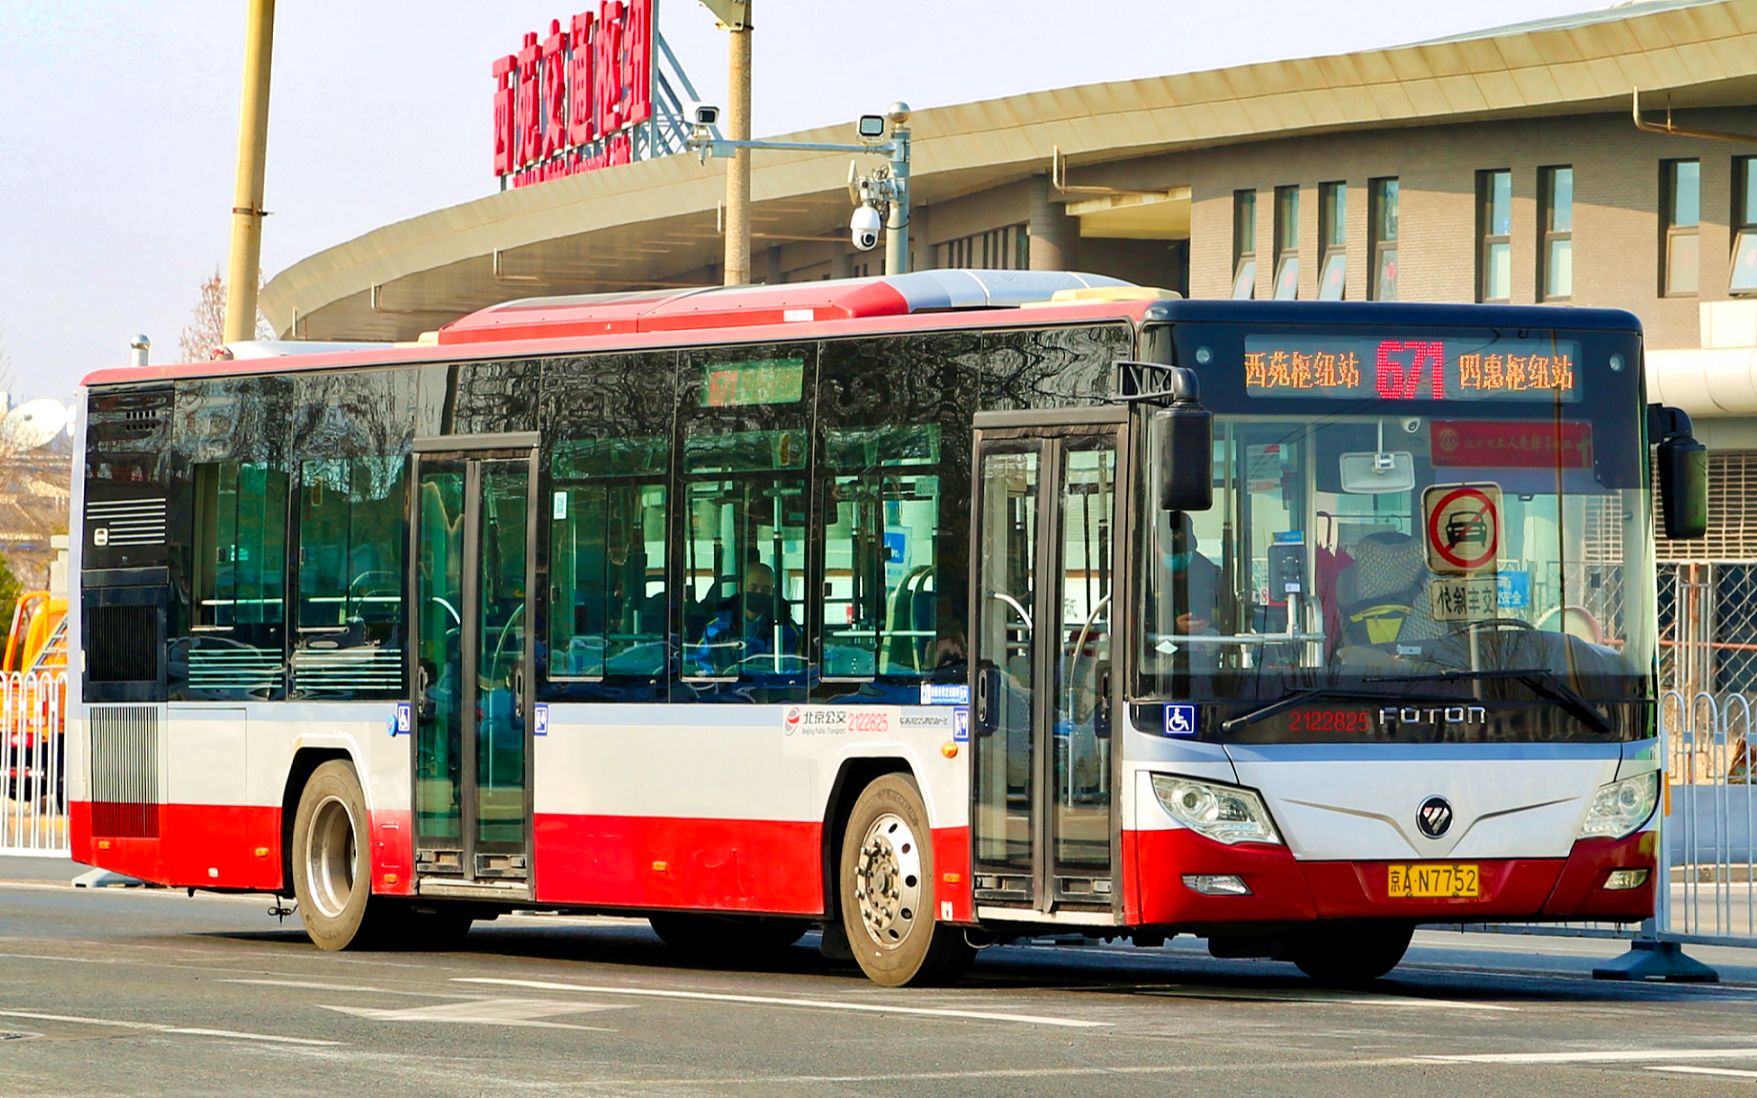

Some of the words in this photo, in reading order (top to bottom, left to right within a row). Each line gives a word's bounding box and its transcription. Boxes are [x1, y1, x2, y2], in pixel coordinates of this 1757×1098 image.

[492, 0, 652, 177] 西苑交通枢纽
[1244, 351, 1360, 389] 西苑枢纽站
[1376, 340, 1444, 400] 671
[1458, 353, 1574, 391] 四惠枢纽站
[803, 710, 847, 725] 北京公交
[848, 713, 889, 733] 2122825
[1289, 710, 1371, 733] 2122825
[1378, 706, 1487, 725] FOTON
